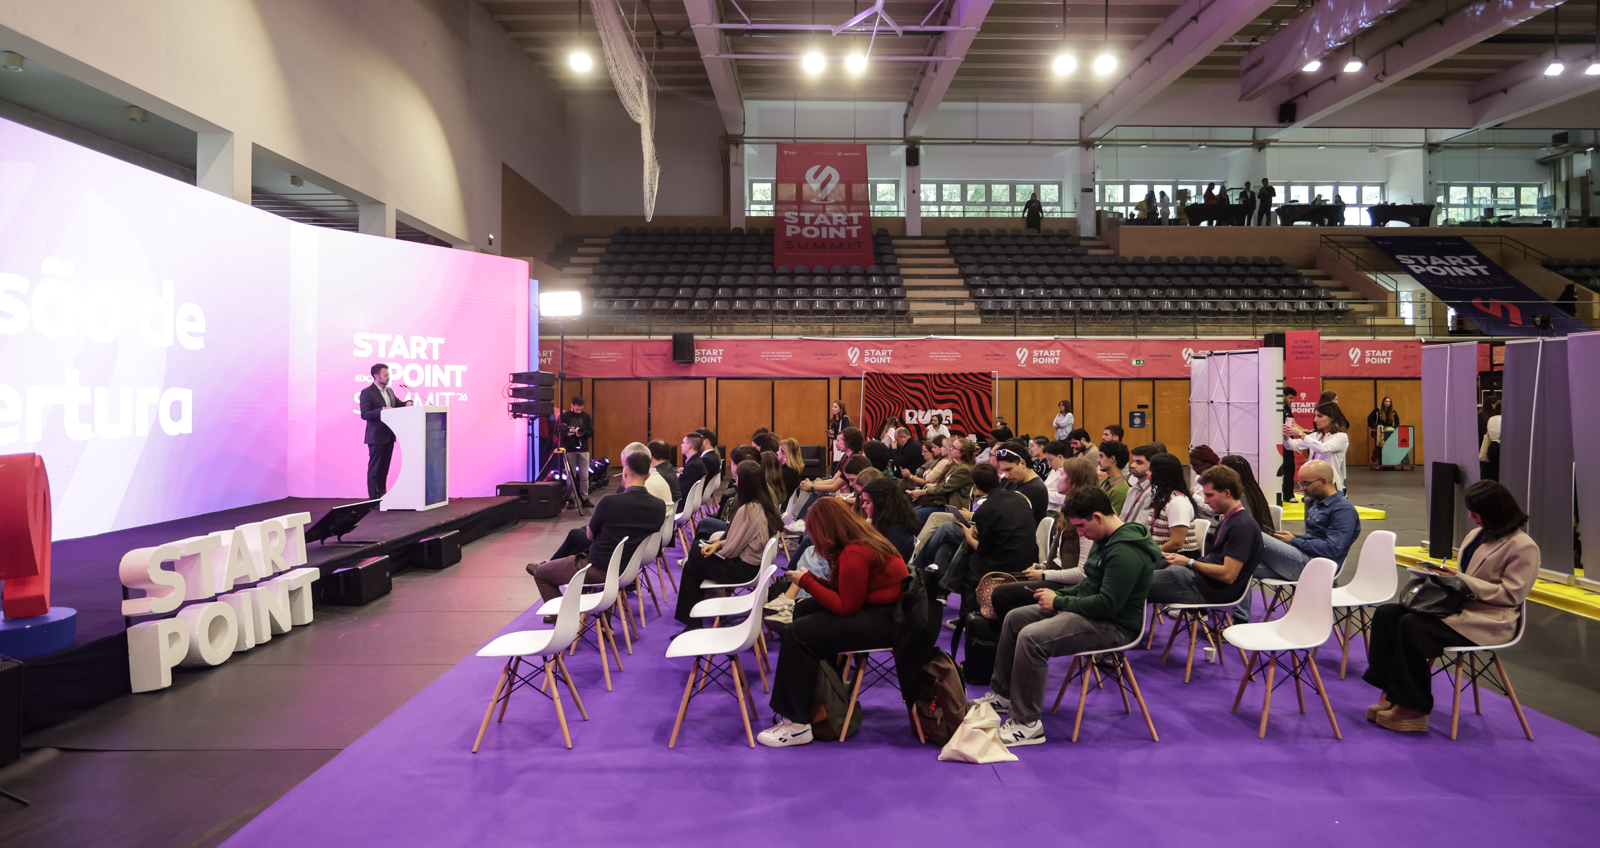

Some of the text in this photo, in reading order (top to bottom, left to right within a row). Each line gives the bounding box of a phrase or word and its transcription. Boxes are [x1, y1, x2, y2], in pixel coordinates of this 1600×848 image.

[784, 211, 863, 225] START
[786, 225, 862, 238] POINT
[784, 240, 864, 250] SUMMIT
[1395, 254, 1480, 266] START
[1409, 265, 1491, 276] POINT
[1420, 275, 1506, 286] SUMMIT
[138, 279, 206, 350] de
[352, 331, 445, 360] START
[864, 349, 893, 357] START
[694, 356, 723, 364] POINT
[354, 375, 374, 383] EDIÇ
[385, 362, 468, 387] POINT
[125, 511, 312, 614] START
[132, 567, 320, 692] POINT
[1012, 730, 1026, 742] N
